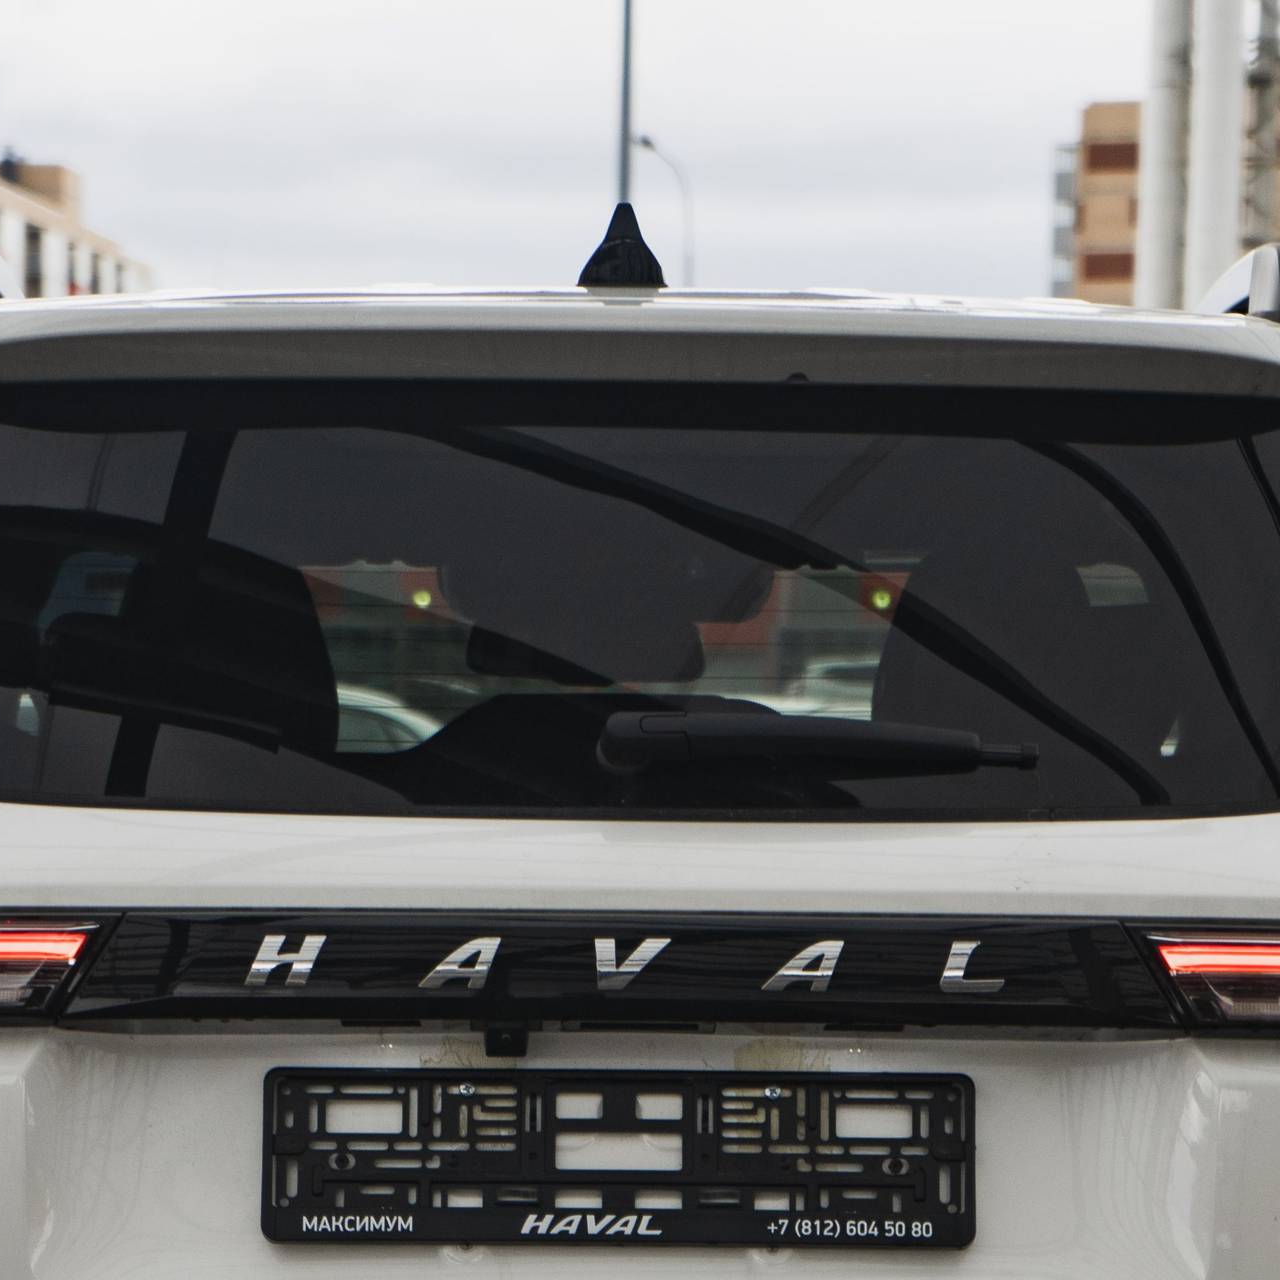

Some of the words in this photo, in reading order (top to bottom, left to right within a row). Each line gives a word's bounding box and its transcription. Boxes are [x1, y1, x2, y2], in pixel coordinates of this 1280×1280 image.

[243, 933, 1007, 993] HAVAL
[301, 1214, 415, 1233] МАКСИМУМ
[520, 1213, 664, 1236] HAVAL
[766, 1217, 790, 1236] +7
[793, 1217, 842, 1240] (812)
[845, 1218, 880, 1238] 604
[883, 1219, 907, 1238] 50
[910, 1220, 934, 1239] 80
